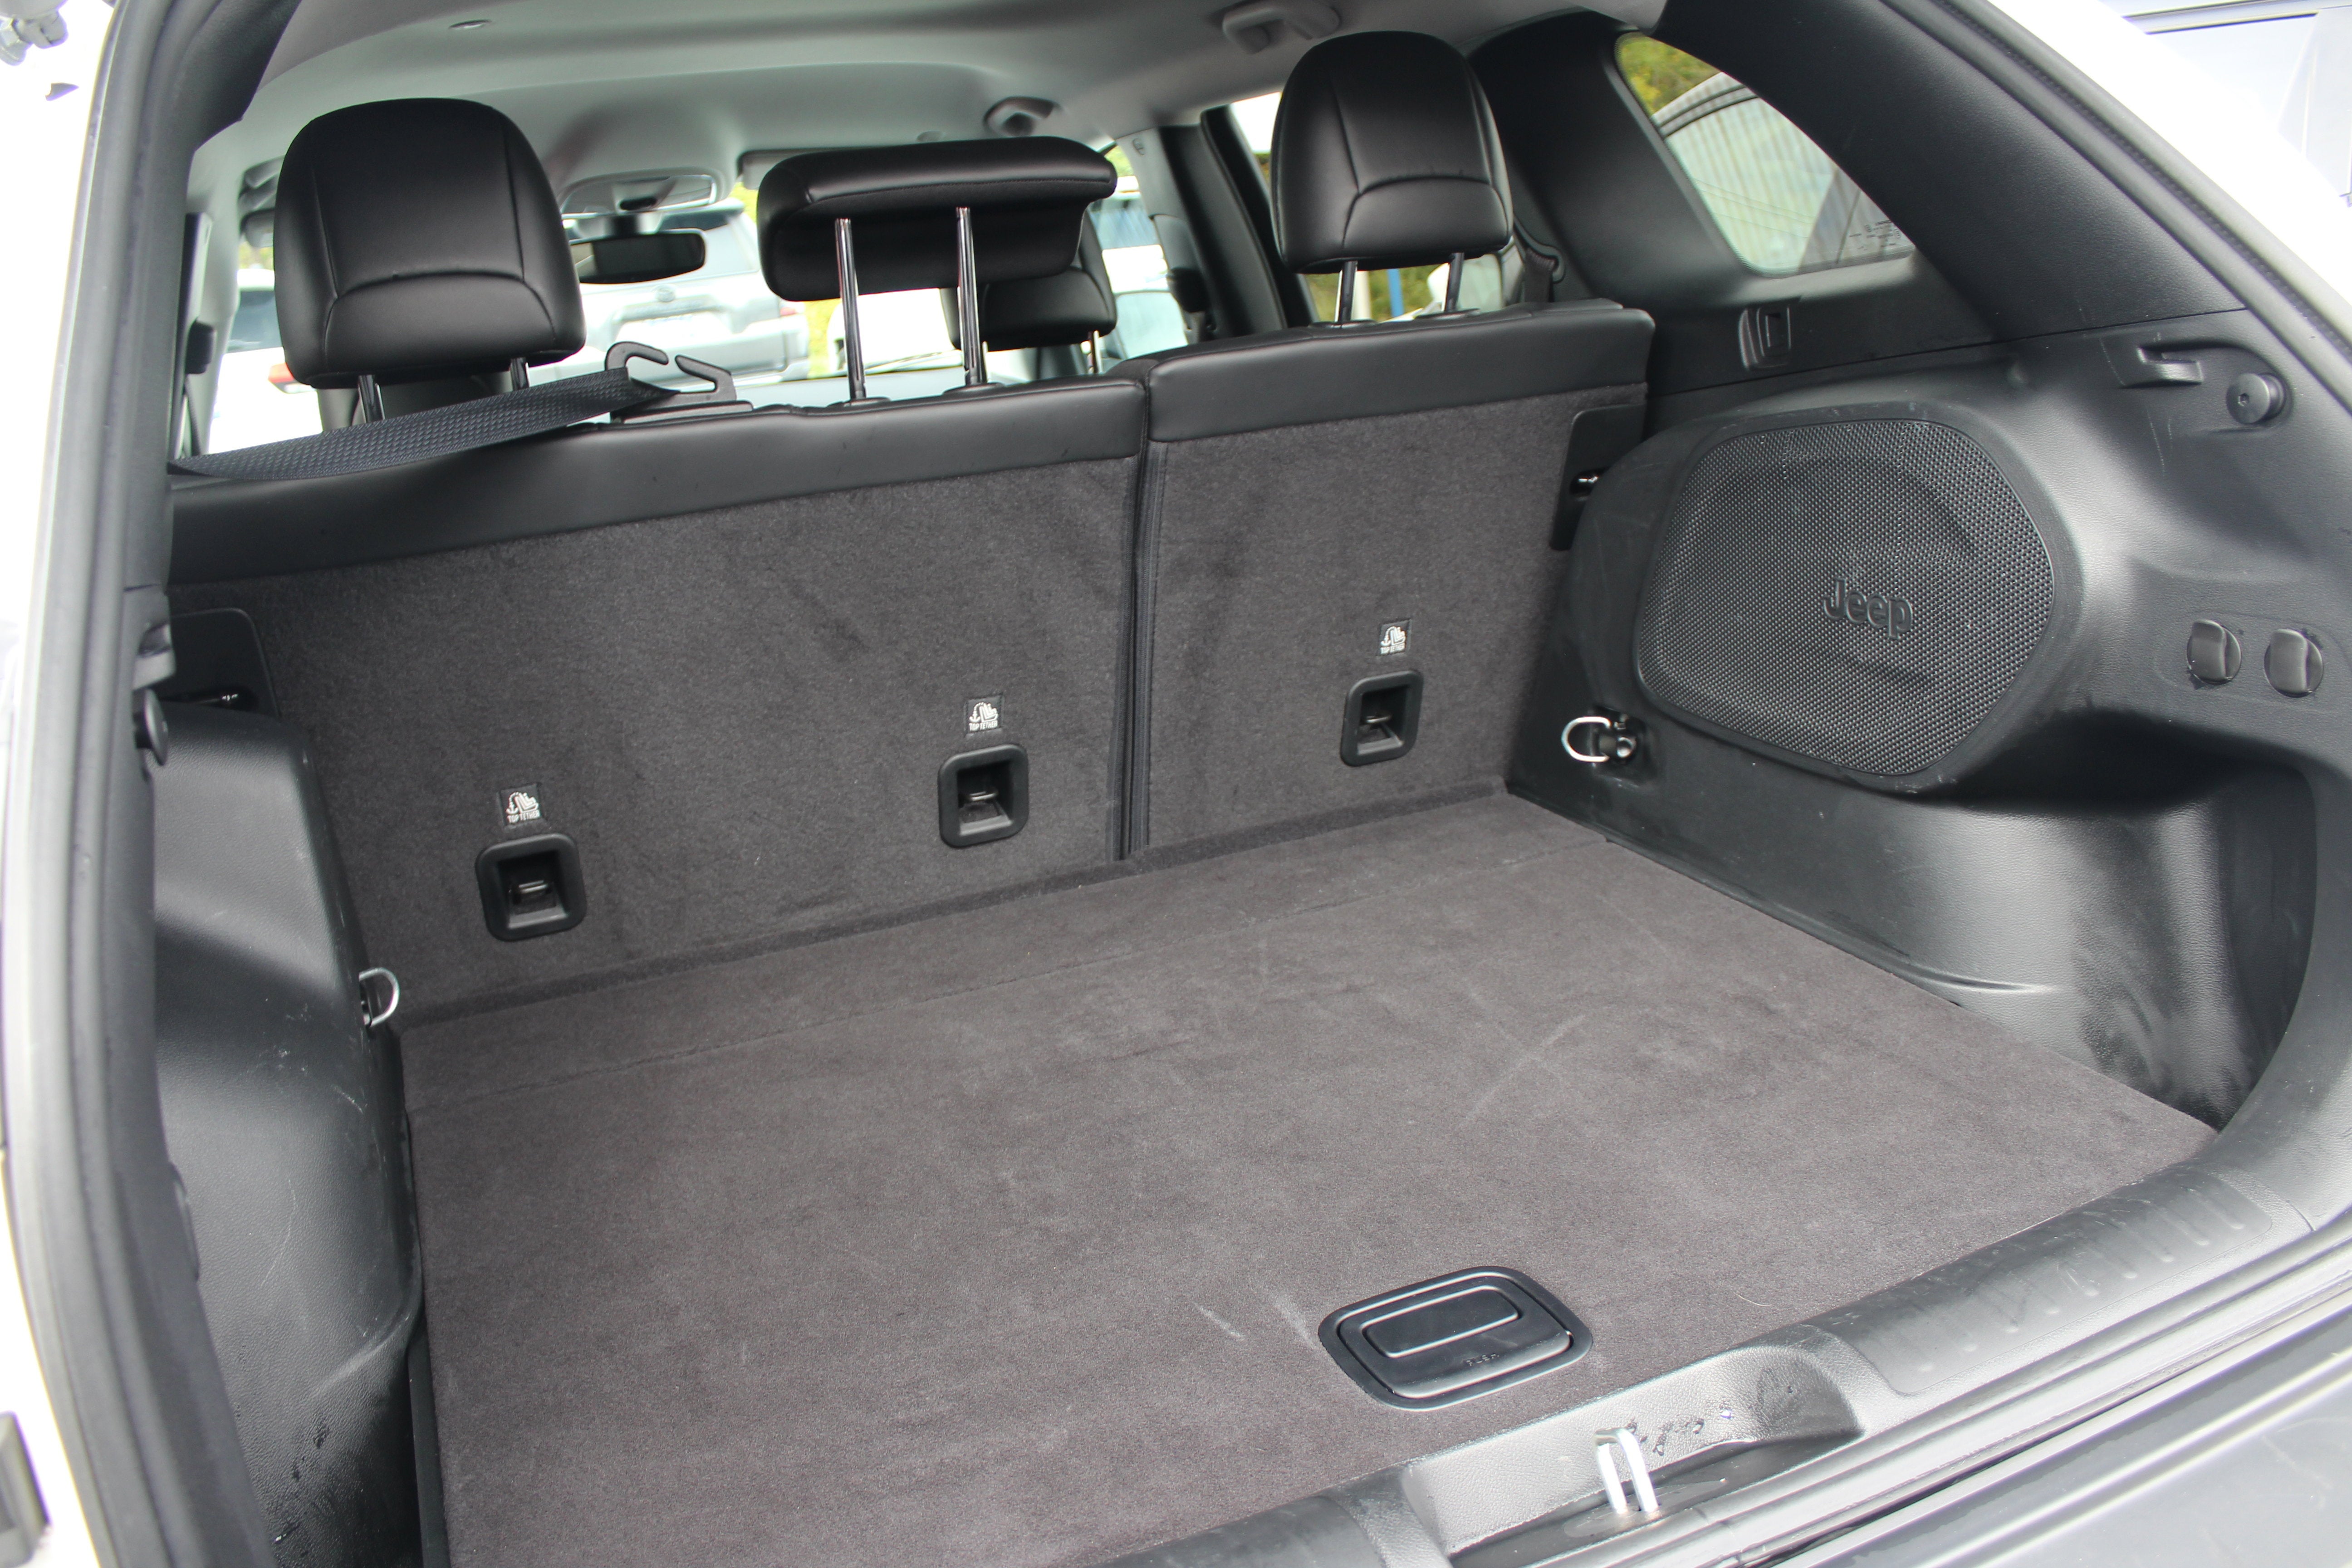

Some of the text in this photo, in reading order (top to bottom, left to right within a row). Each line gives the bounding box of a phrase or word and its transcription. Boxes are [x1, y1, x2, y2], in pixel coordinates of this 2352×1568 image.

[1823, 577, 1913, 638] Jeep
[969, 720, 998, 731] TOP TETHER
